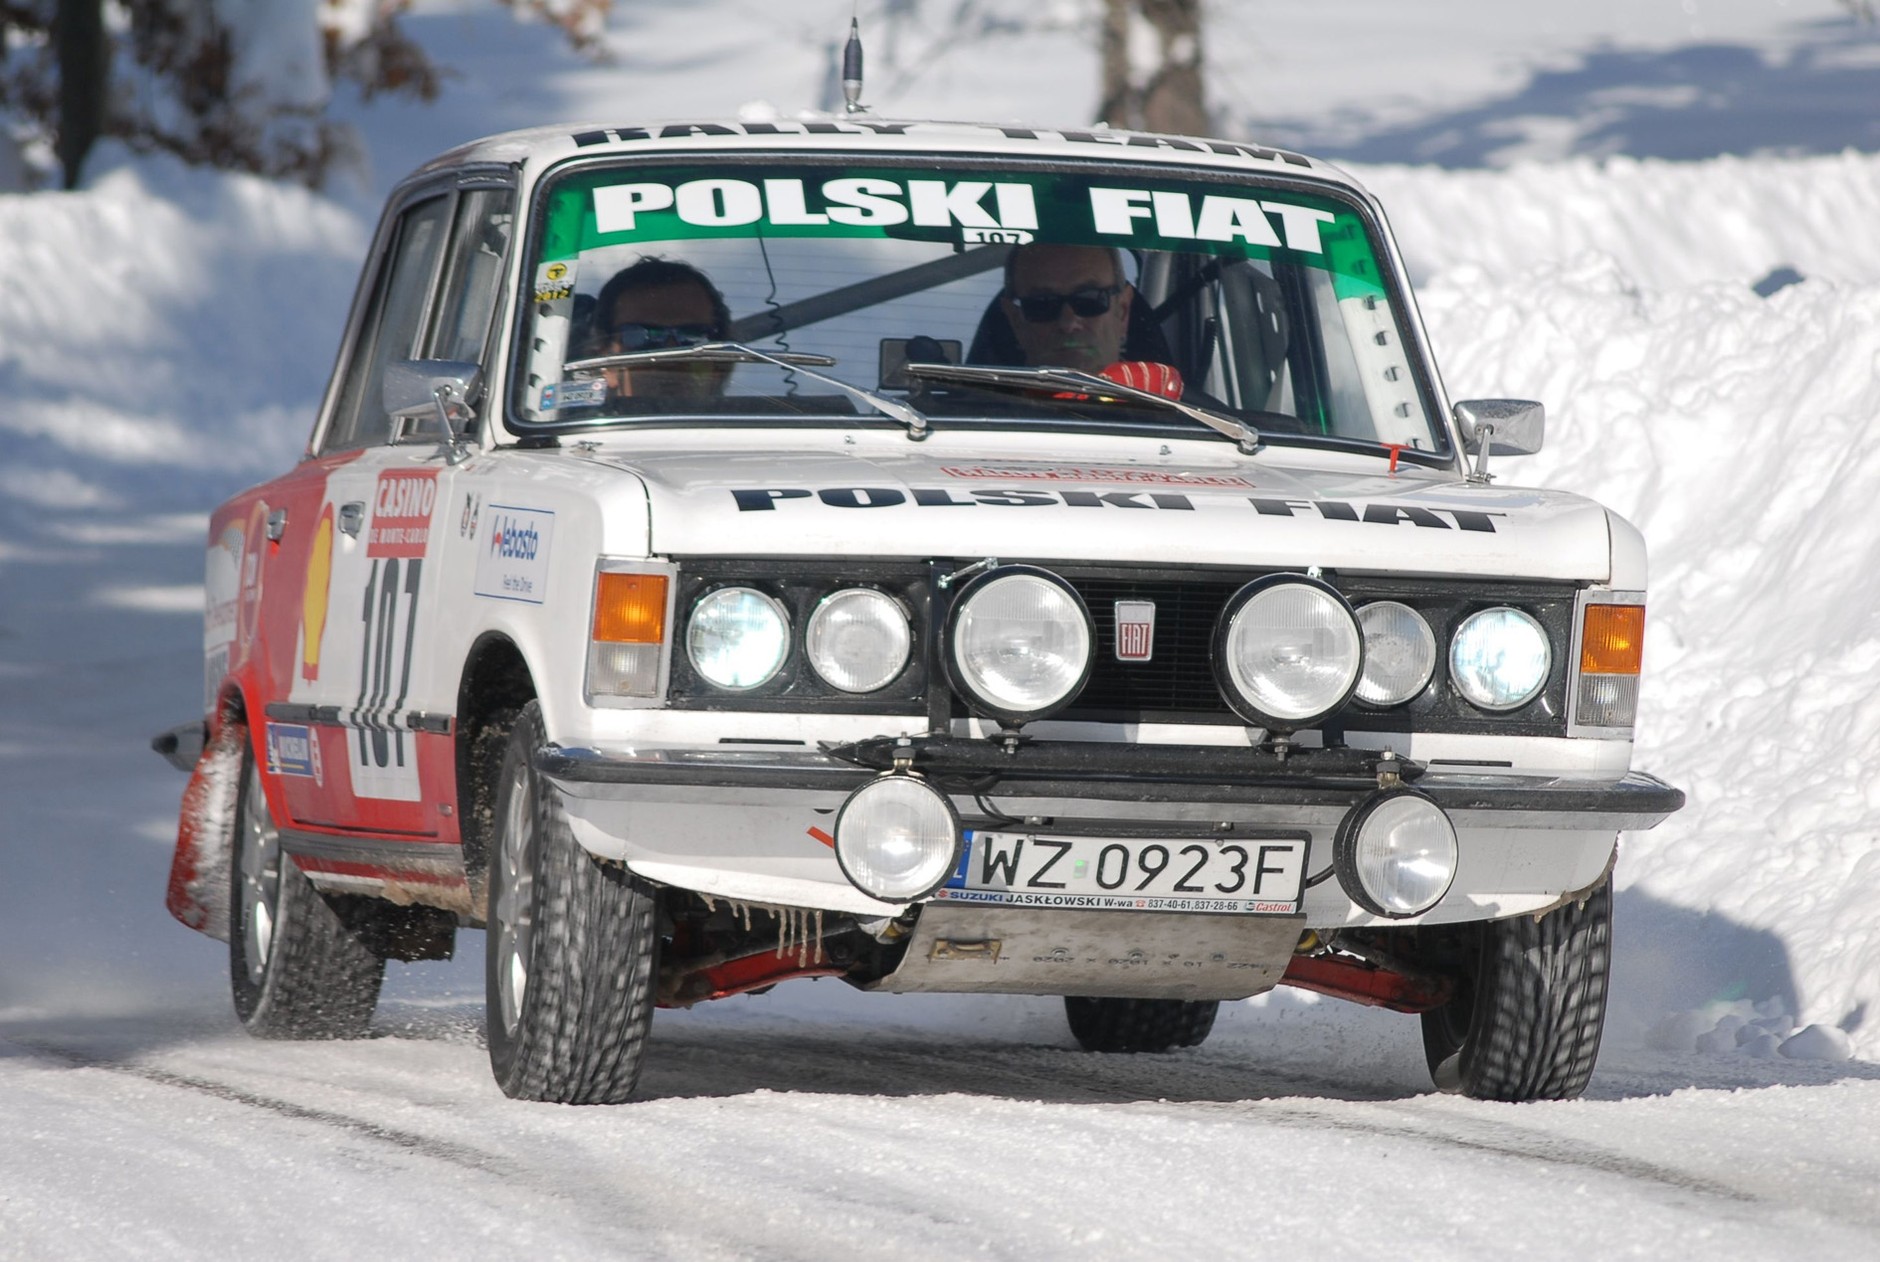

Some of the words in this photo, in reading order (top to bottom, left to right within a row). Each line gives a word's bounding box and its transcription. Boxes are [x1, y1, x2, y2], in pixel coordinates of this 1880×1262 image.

[571, 122, 916, 148] RALLY
[980, 125, 1313, 169] TEAM
[592, 177, 1039, 234] POLSKI
[1089, 187, 1336, 255] FIAT
[976, 232, 1020, 244] 107
[376, 478, 437, 517] CASINO
[730, 488, 1197, 514] POLSKI
[1248, 498, 1507, 533] FIAT
[1121, 623, 1149, 655] FIAT
[981, 837, 1073, 889] WZ
[1096, 844, 1295, 895] 0923F
[950, 891, 1004, 903] SUZUKI
[1005, 893, 1101, 907] JASKŁOWSKI
[1103, 898, 1134, 908] W-wa
[1255, 902, 1293, 913] Castrol
